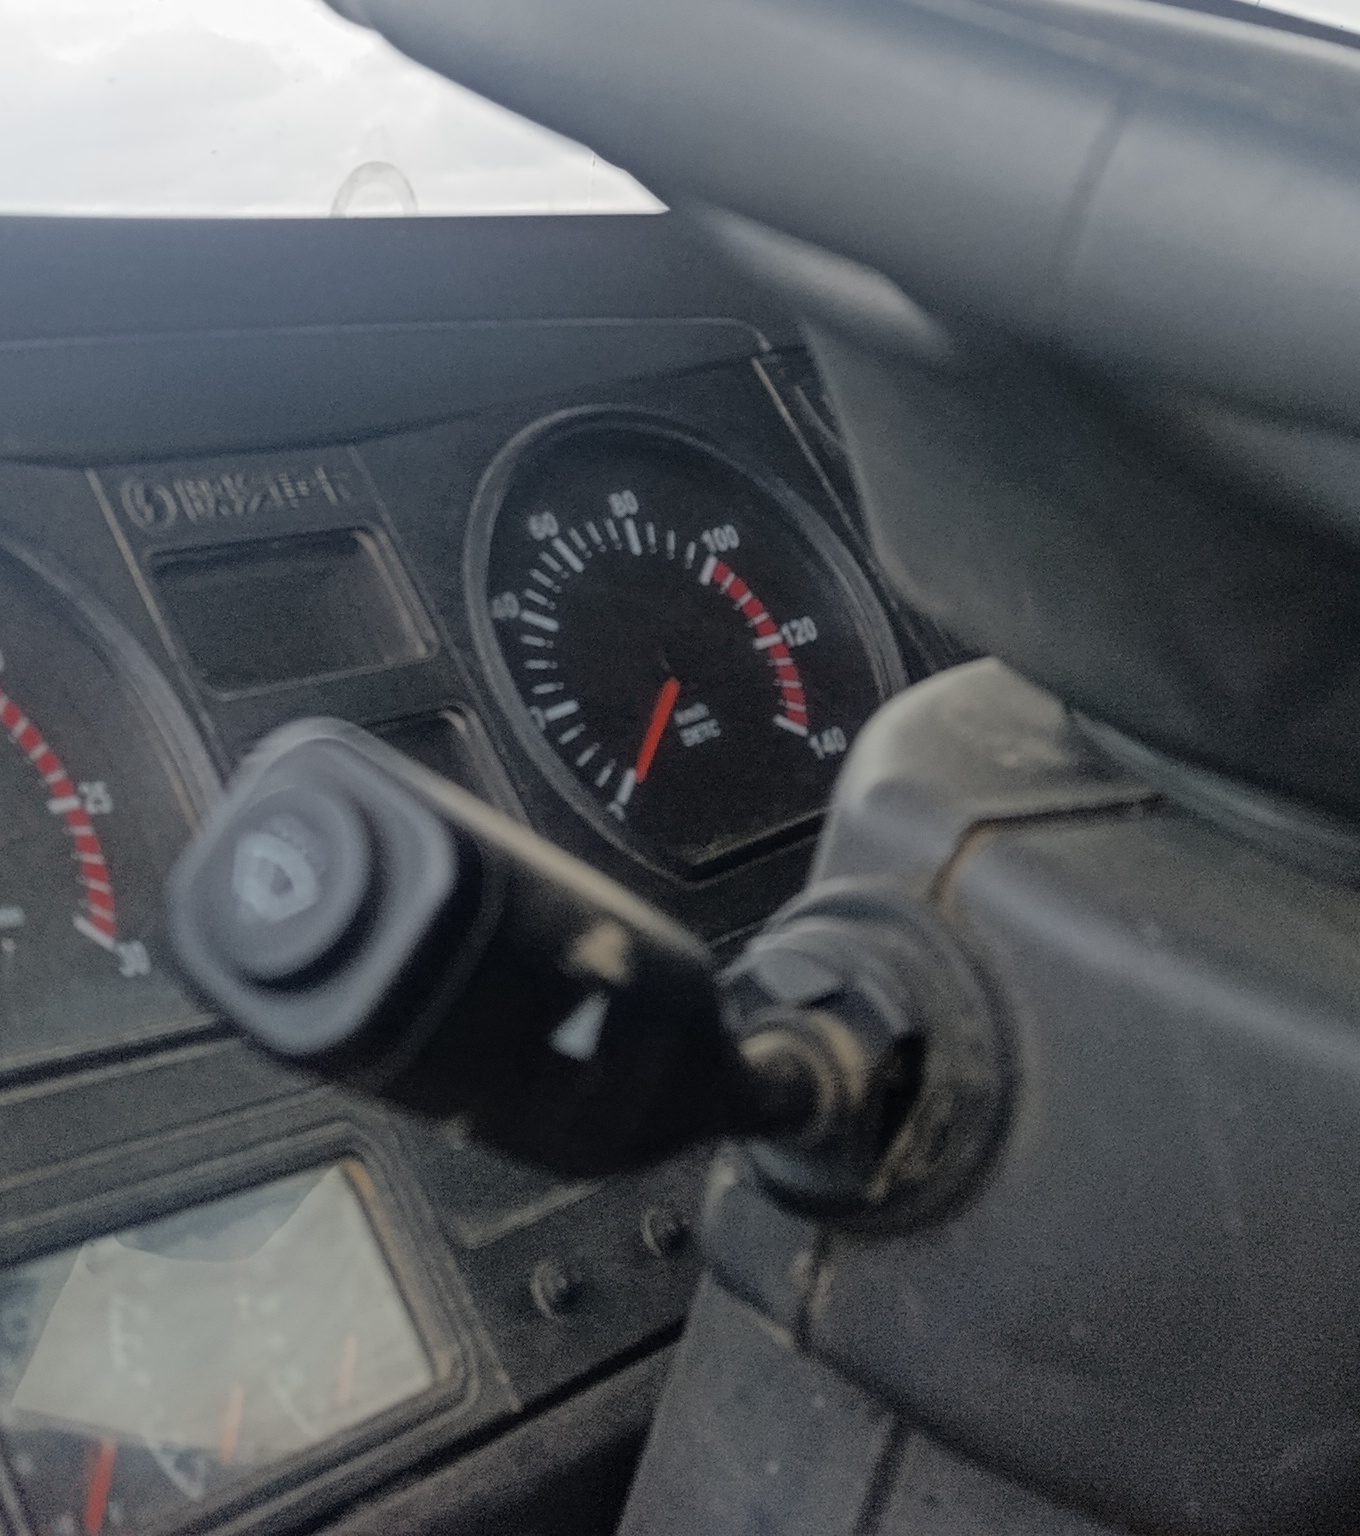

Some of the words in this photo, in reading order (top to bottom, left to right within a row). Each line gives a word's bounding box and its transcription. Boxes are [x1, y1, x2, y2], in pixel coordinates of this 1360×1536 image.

[608, 490, 639, 518] 80
[701, 524, 739, 554] 100
[781, 615, 818, 648] 120
[807, 725, 848, 760] 140
[78, 780, 114, 815] 25
